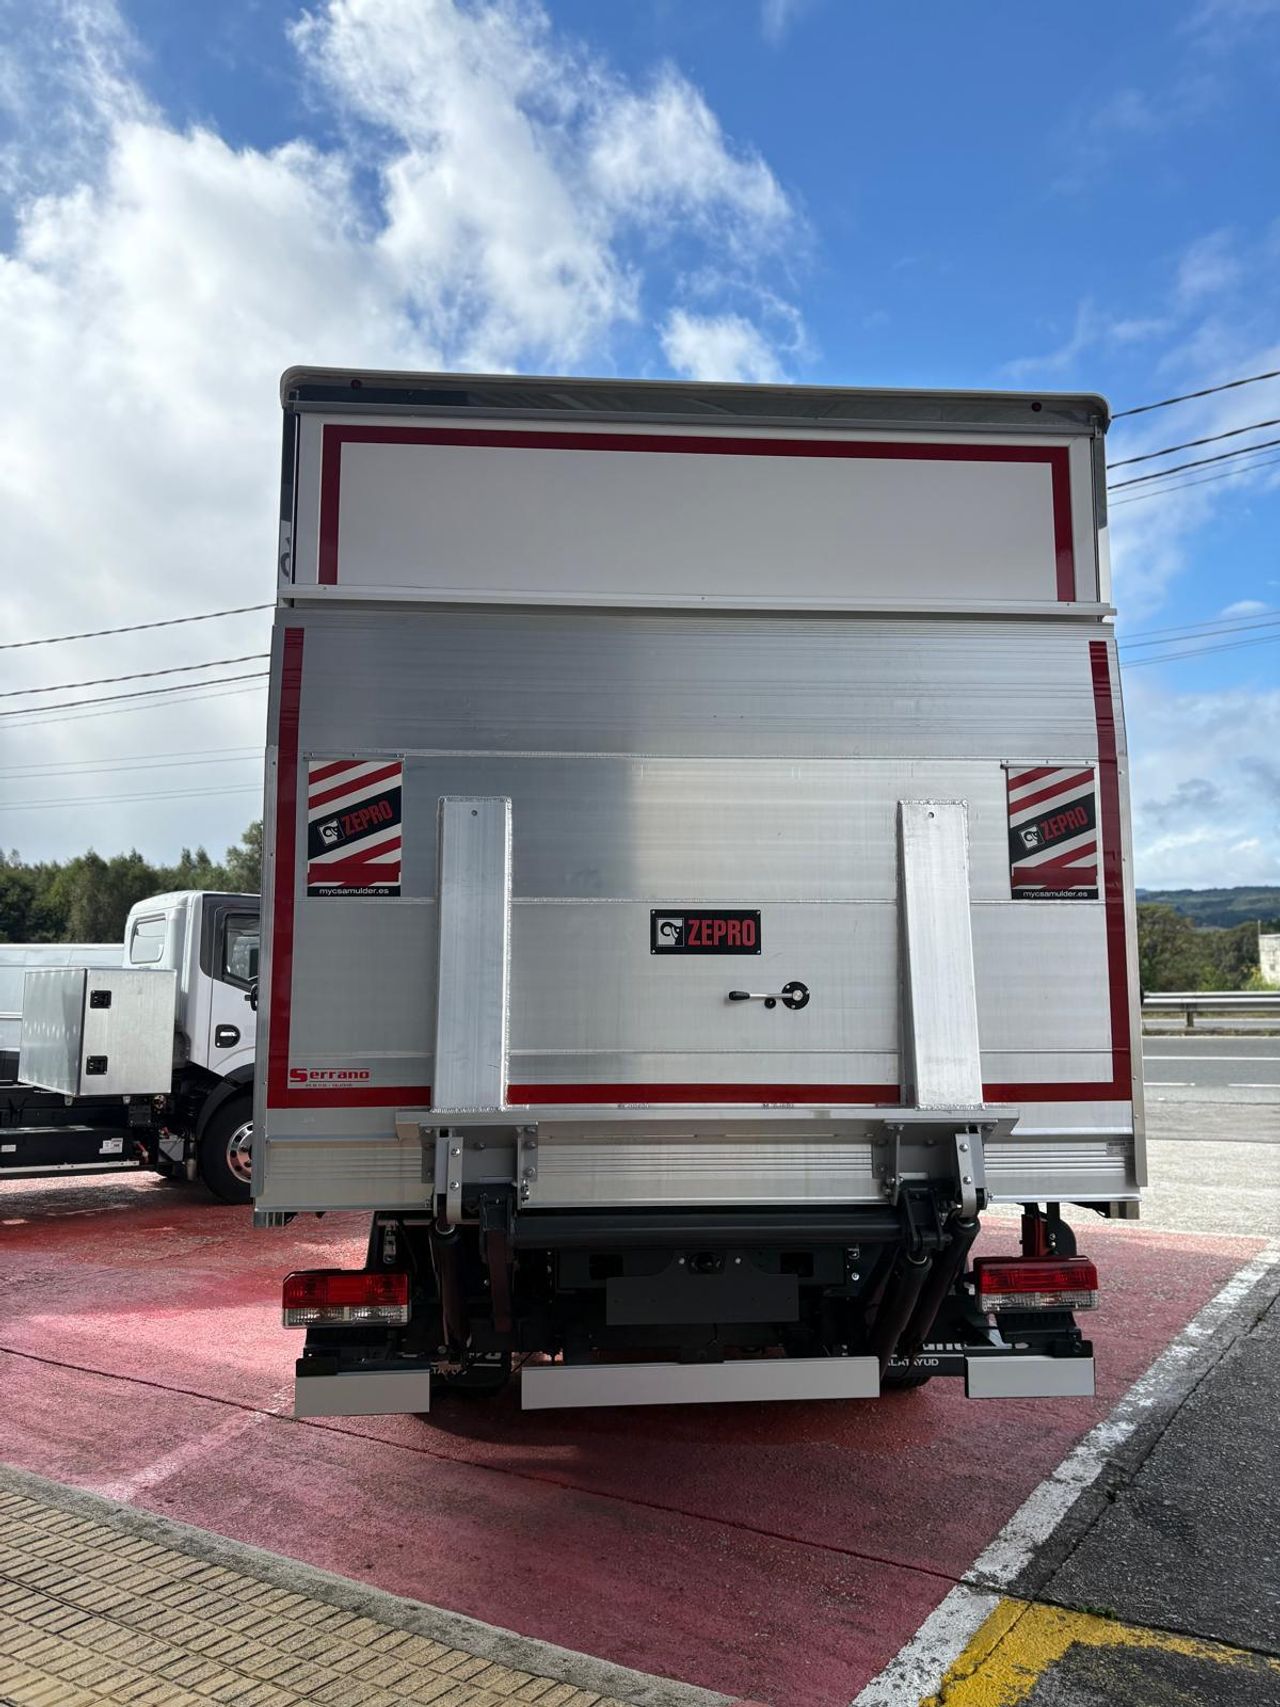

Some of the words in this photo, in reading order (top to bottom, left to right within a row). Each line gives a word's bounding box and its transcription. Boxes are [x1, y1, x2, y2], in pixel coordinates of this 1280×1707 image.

[342, 800, 392, 836] ZEPRO
[1040, 806, 1089, 841] ZEPRO
[319, 888, 389, 896] mycsamulder.es
[1022, 889, 1088, 898] mycsamulder.es
[687, 919, 756, 946] ZEPRO
[289, 1068, 370, 1083] Serrano
